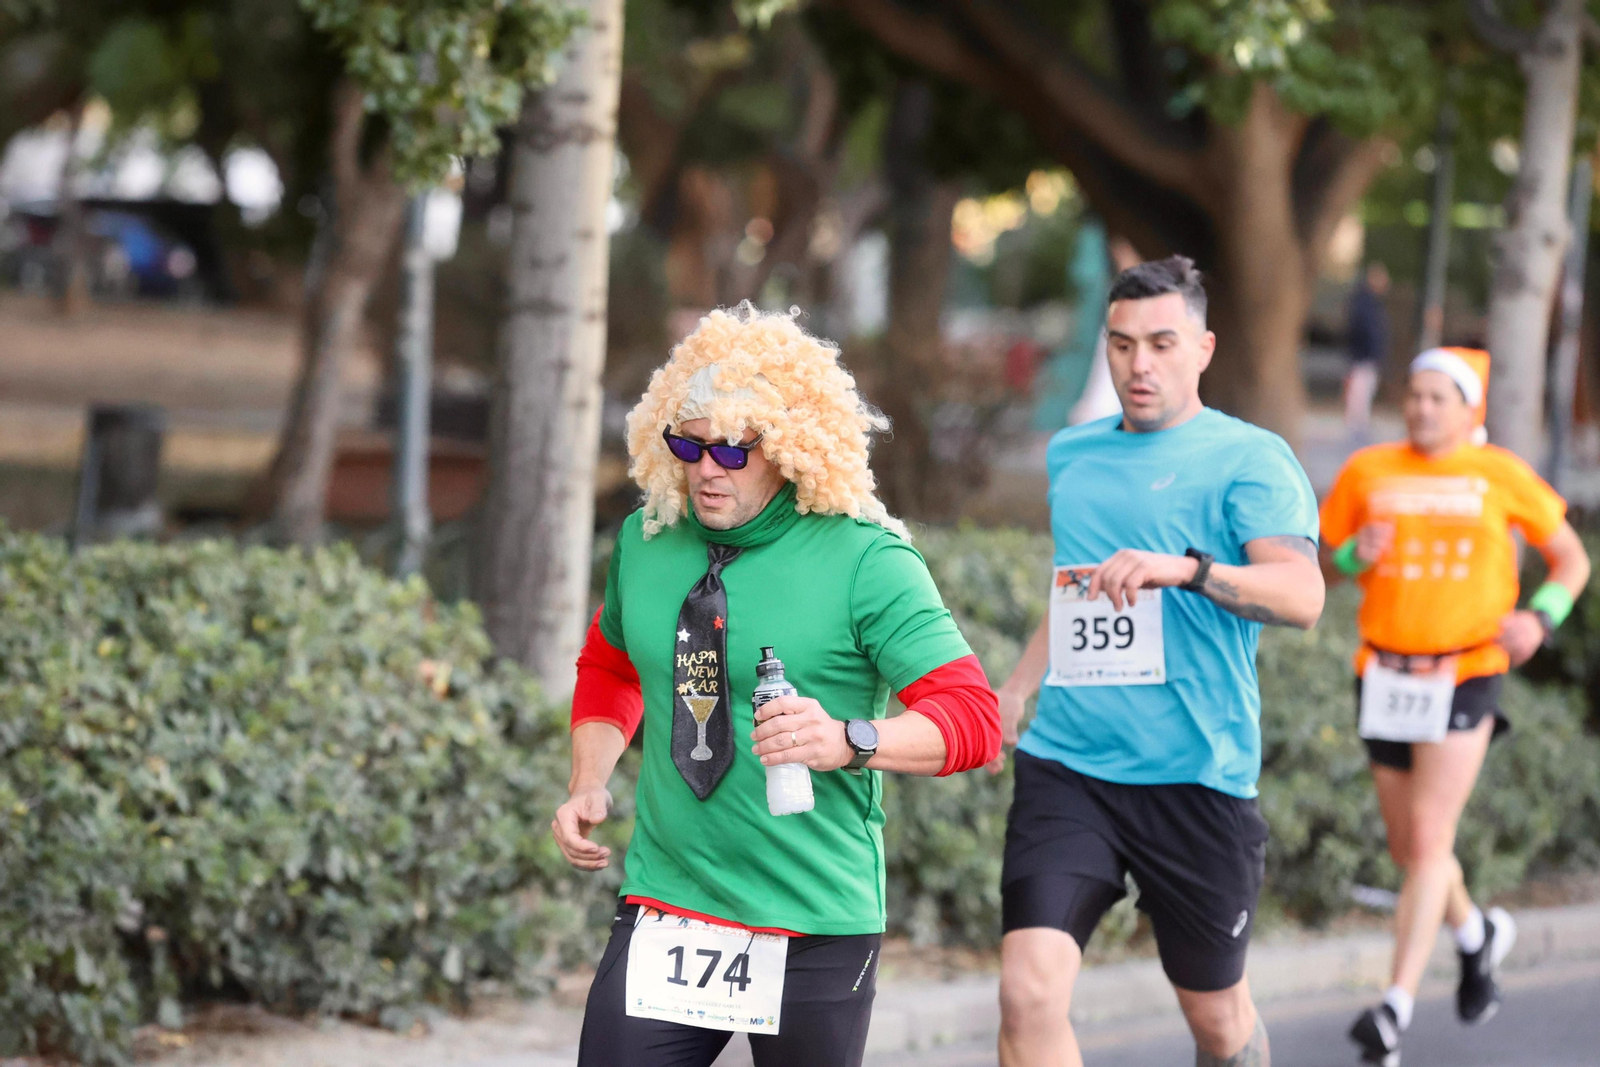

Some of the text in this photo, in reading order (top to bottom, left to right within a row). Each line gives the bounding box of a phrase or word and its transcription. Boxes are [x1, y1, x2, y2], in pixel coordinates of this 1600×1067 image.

[1072, 616, 1135, 652] 359
[687, 665, 719, 679] NEW
[666, 945, 752, 992] 174
